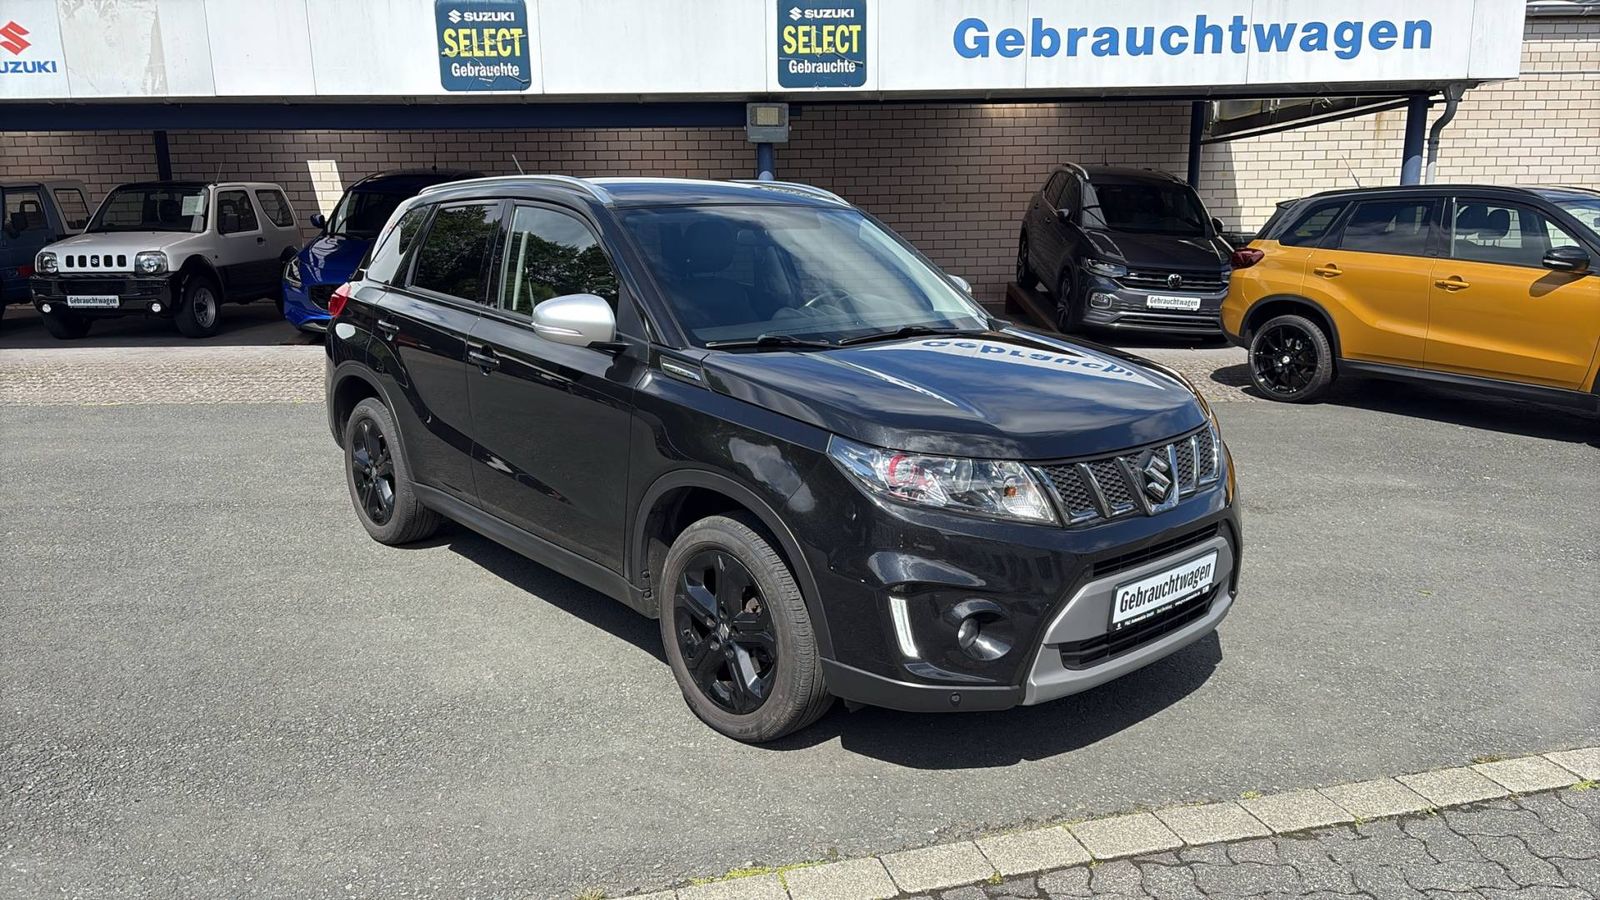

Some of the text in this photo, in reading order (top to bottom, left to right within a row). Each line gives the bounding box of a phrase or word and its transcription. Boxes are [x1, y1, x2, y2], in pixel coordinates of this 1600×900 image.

[463, 11, 515, 21] SUZUKI
[804, 8, 854, 18] SUZUKI
[443, 27, 523, 57] SELECT
[783, 25, 861, 54] SELECT
[953, 14, 1433, 60] Gebrauchtwagen
[0, 61, 58, 73] UZUKI
[451, 62, 520, 77] Gebrauchte
[788, 59, 856, 73] Gebrauchte
[69, 297, 117, 305] Gebrauchtwagen
[1150, 296, 1198, 306] Gebrauchtwagen
[1120, 562, 1211, 614] Gebrauchtwagen
